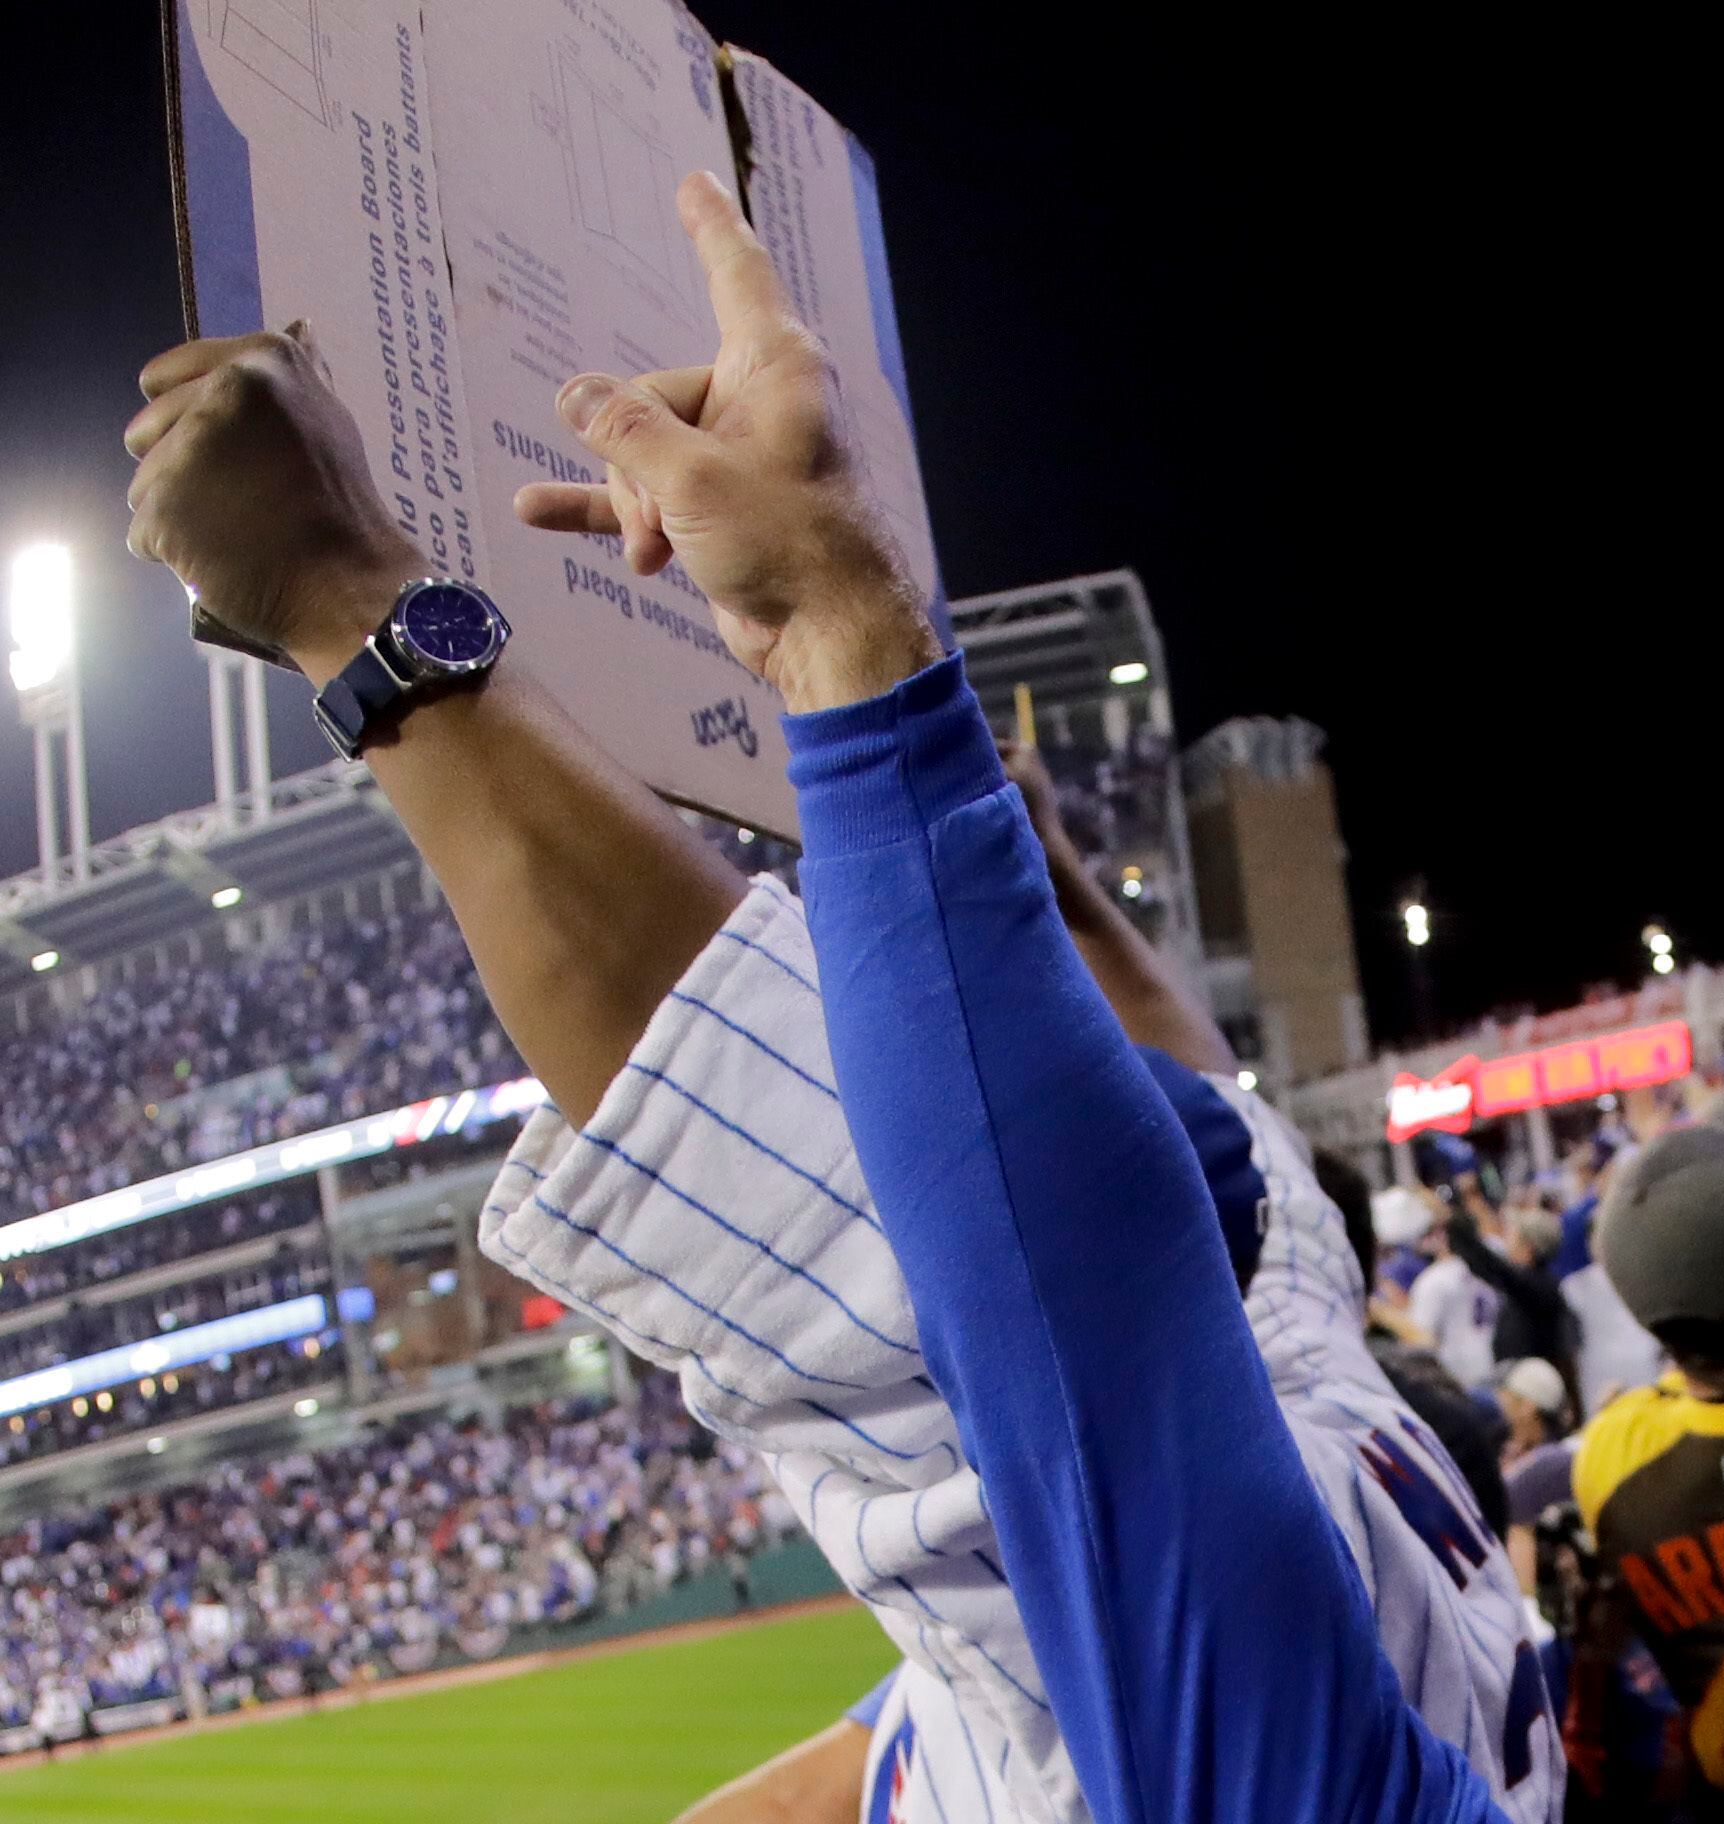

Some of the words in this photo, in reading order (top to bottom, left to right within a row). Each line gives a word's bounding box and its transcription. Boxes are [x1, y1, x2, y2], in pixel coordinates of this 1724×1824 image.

[396, 22, 422, 154] battants
[352, 111, 381, 221] Board
[407, 164, 432, 244] trois
[382, 121, 434, 398] presentaciones
[366, 230, 411, 481] Presentation
[424, 288, 463, 493] d'affichage
[414, 407, 445, 500] para
[430, 512, 450, 574] ico
[454, 507, 476, 579] eau
[563, 556, 634, 619] Board
